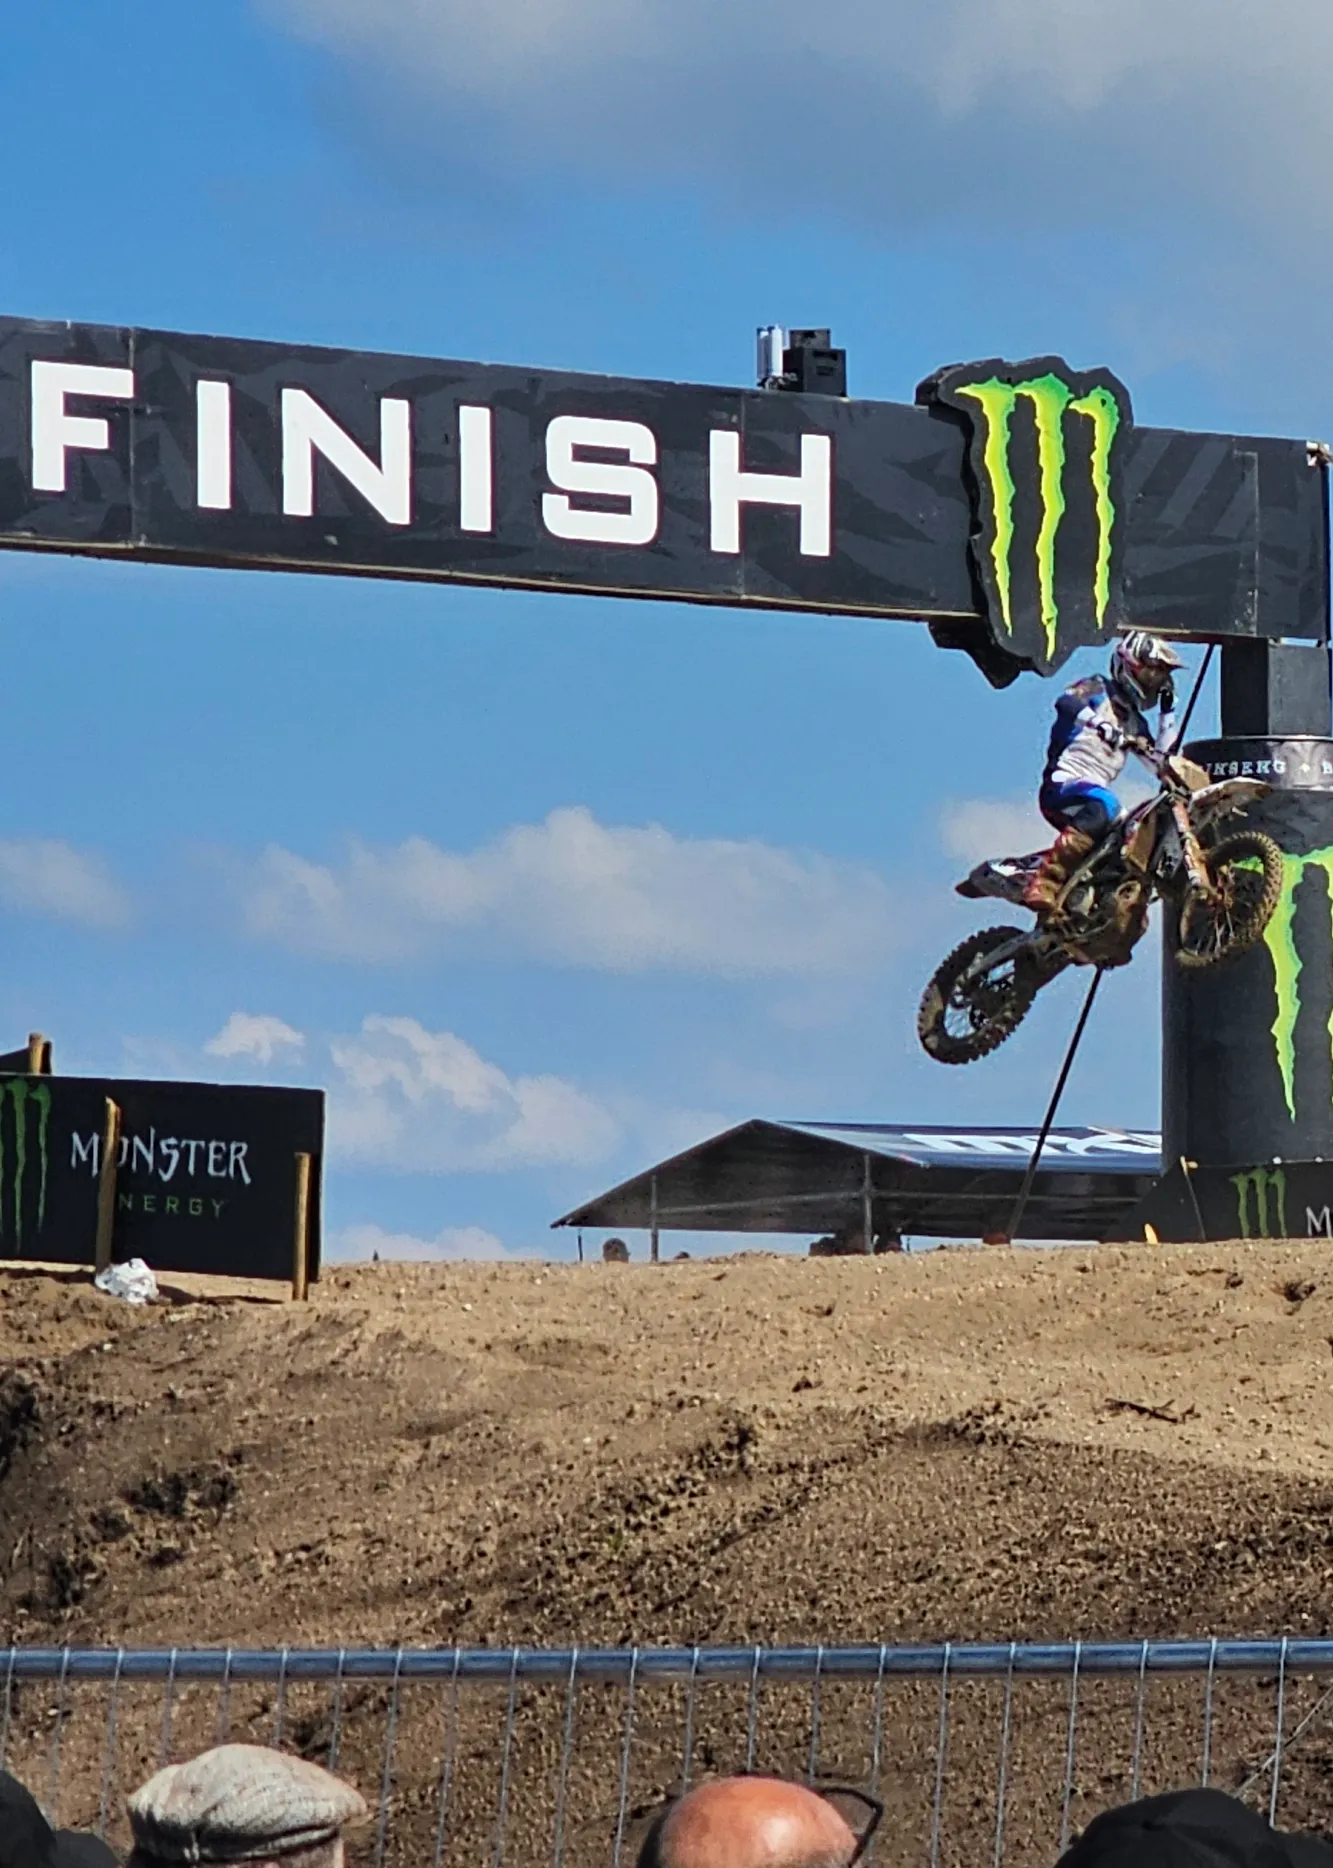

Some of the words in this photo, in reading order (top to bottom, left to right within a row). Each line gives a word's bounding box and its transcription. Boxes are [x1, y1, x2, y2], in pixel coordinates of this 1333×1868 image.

[31, 360, 832, 557] FINISH
[70, 1125, 252, 1186] MNSTER
[118, 1192, 229, 1220] NERGY
